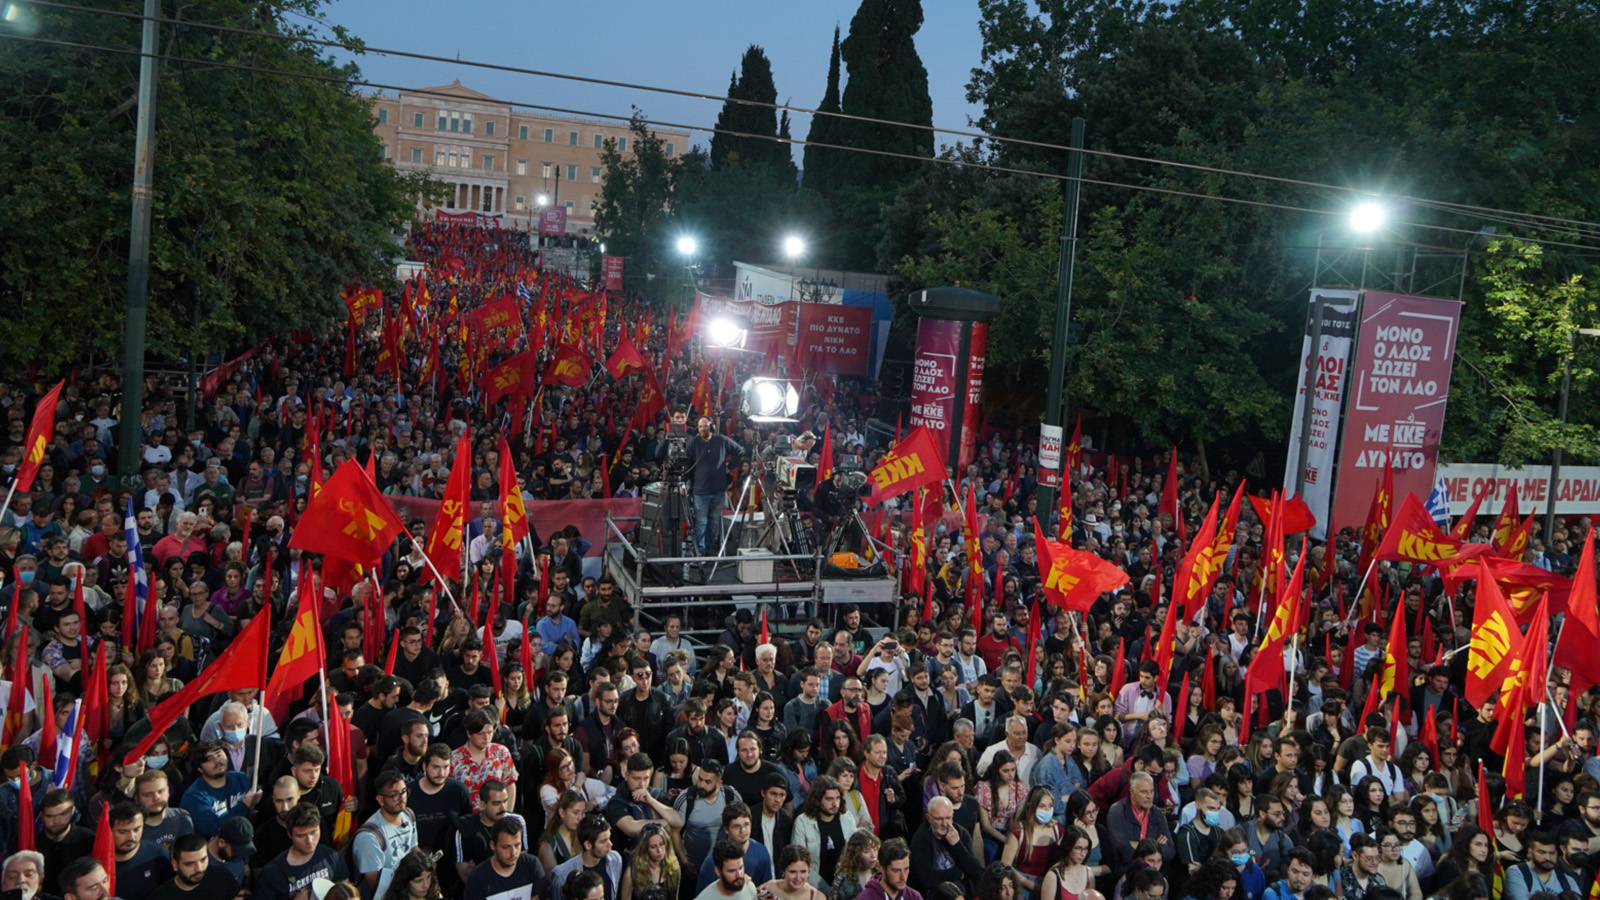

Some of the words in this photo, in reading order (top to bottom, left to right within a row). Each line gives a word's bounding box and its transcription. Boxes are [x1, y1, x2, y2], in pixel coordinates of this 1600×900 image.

[809, 324, 825, 332] ΠΙΟ
[826, 325, 861, 334] ΔΥΝΑΤΟ
[1331, 319, 1351, 329] ΤΟΥΣ
[824, 336, 844, 344] ΝΙΚΗ
[1376, 325, 1423, 344] ΜΟΝΟ
[825, 345, 837, 353] ΤΟ
[839, 347, 857, 355] ΛΑΟ
[1373, 342, 1385, 358] Ο
[1387, 343, 1432, 362] ΛΑΟΣ
[915, 358, 938, 369] ΜΟΝΟ
[1371, 359, 1417, 377] ΣΩΖΕΙ
[914, 366, 920, 374] Ο
[919, 367, 944, 378] ΛΑΟΣ
[913, 374, 936, 385] ΣΩΖΕΙ
[1370, 377, 1401, 394] ΤΟΝ
[1402, 379, 1438, 396] ΛΑΟ
[913, 382, 927, 392] ΤΟΝ
[927, 385, 950, 394] ΛΑΟ
[911, 404, 922, 415] ΜΕ
[923, 406, 944, 418] ΚΚΕ
[1311, 408, 1328, 417] ΟΝΟ
[1364, 423, 1389, 443] ΜΕ
[1393, 425, 1425, 444] ΚΚΕ
[1355, 449, 1425, 470] ΔΥΝΑΤΟ
[1304, 468, 1318, 482] ΚΕ
[1522, 478, 1547, 501] ΜΕ
[1398, 529, 1461, 561] ΚΚΕ
